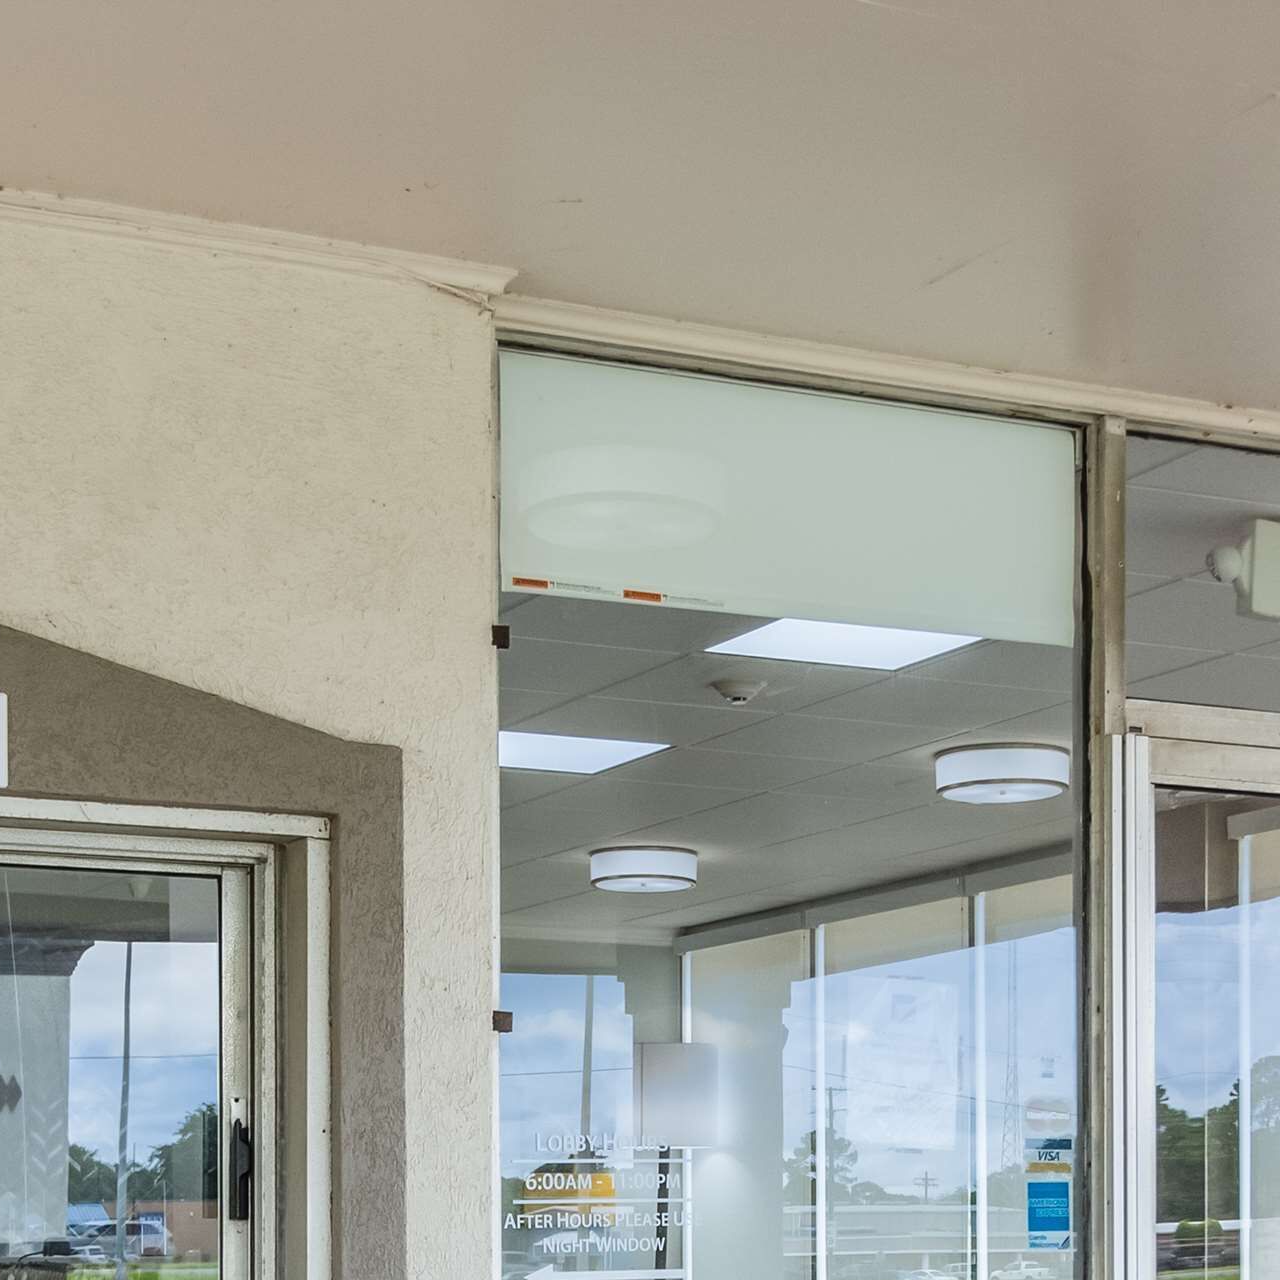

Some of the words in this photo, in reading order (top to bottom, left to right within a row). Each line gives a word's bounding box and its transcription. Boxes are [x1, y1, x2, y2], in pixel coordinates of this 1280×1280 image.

[536, 1133, 596, 1152] LOBBY
[1038, 1150, 1061, 1161] VISA
[525, 1173, 593, 1190] 6:00AM
[611, 1173, 681, 1190] 11:00PM
[504, 1212, 553, 1230] AFTER
[557, 1212, 611, 1229] HOURS
[615, 1212, 669, 1228] PLEASE
[543, 1239, 593, 1254] NIGHT
[596, 1237, 666, 1252] WINDOW
